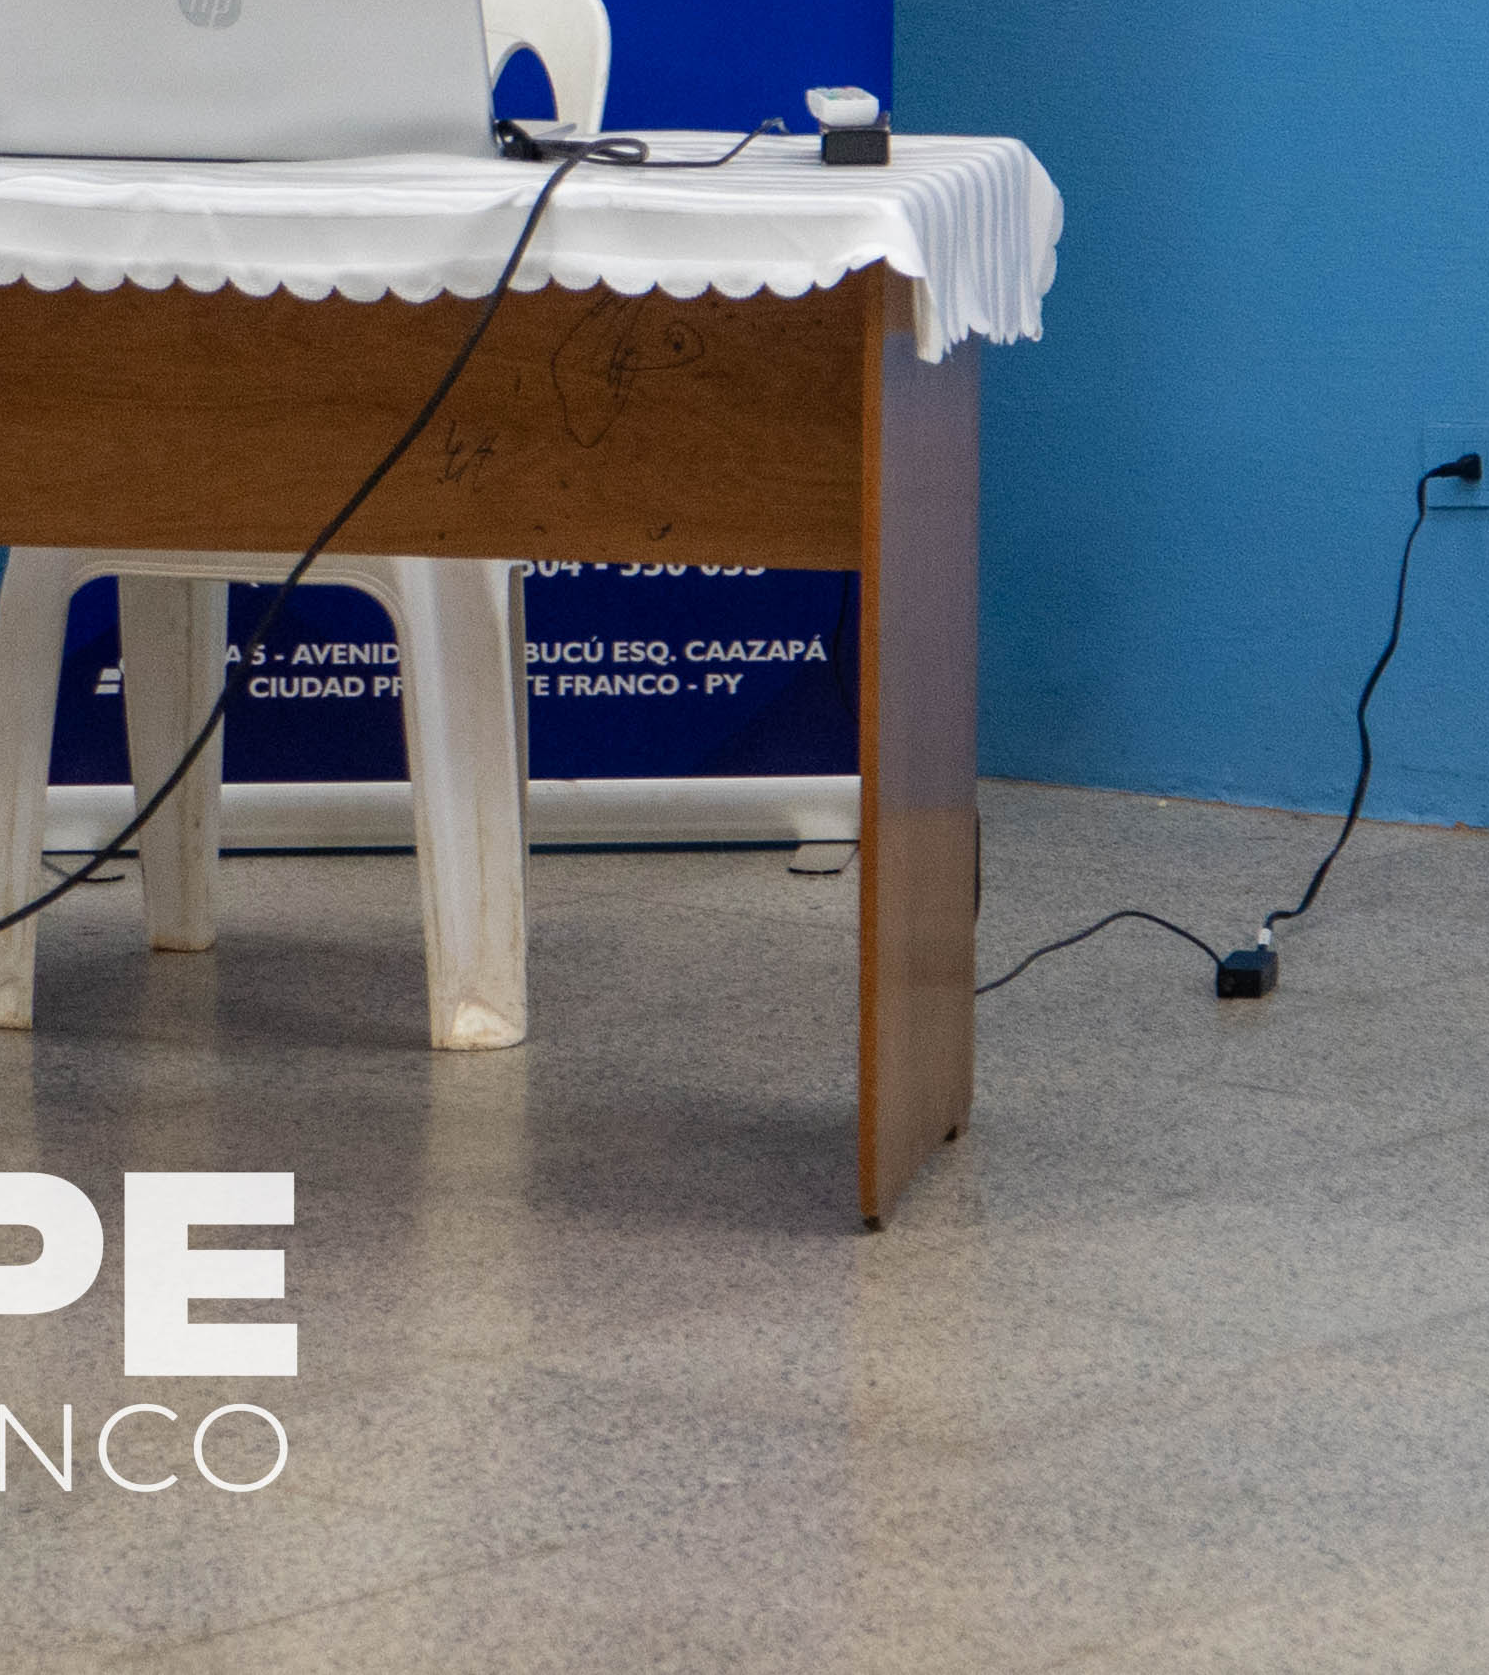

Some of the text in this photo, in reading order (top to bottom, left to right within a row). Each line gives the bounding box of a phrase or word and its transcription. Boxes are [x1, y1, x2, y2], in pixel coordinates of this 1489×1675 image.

[292, 644, 400, 664] AVENID
[525, 637, 603, 663] BUCÚ
[613, 642, 677, 665] ESQ.
[685, 634, 826, 662] CAAZAPÁ
[249, 677, 365, 698] CIUDAD
[558, 674, 679, 696] FRANCO
[705, 673, 744, 694] PY
